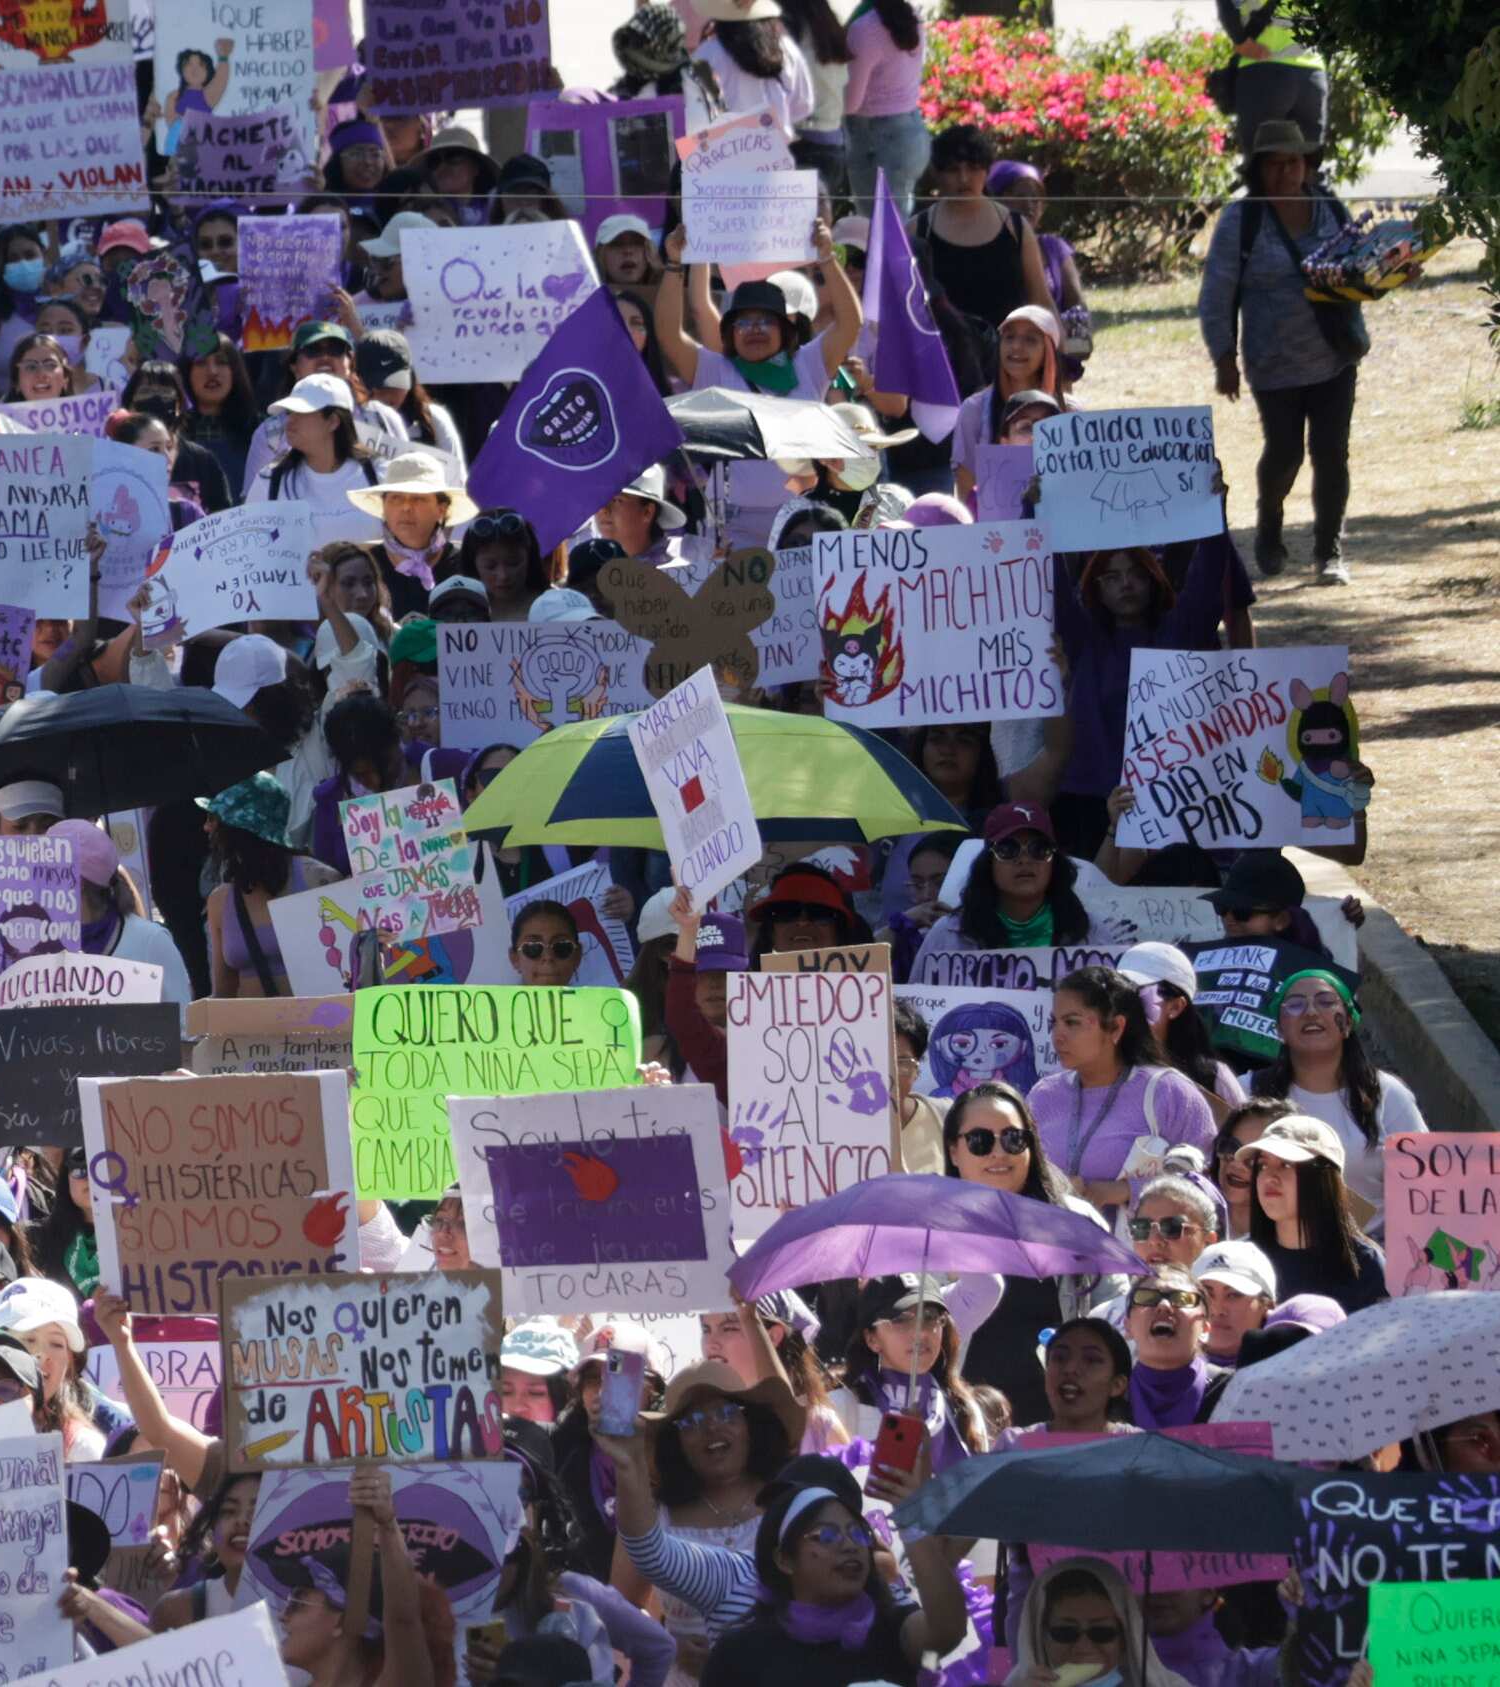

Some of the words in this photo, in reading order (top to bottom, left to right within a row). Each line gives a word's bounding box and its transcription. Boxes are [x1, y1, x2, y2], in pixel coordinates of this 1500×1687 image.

[246, 32, 309, 53] HABER
[234, 58, 304, 79] NACIDO
[26, 111, 55, 131] QUE
[64, 102, 136, 125] LUCHAN
[4, 143, 33, 162] POR
[40, 139, 79, 158] LAS
[86, 134, 124, 154] QUE
[223, 155, 252, 171] AL
[59, 162, 143, 190] VIOLAN
[440, 258, 502, 304] Que
[544, 395, 585, 436] GRITO
[1155, 417, 1181, 437] no
[724, 556, 767, 586] NO
[818, 530, 928, 575] MENOS
[898, 555, 1054, 633] MACHITOS
[446, 630, 478, 654] NO
[445, 663, 493, 687] VINE
[899, 668, 1057, 716] MICHITOS
[1129, 670, 1165, 713] POR
[1166, 651, 1207, 684] LAS
[1158, 656, 1258, 728] MUJERES
[443, 699, 497, 720] TENGO
[637, 681, 699, 746] MARCHO
[1123, 681, 1286, 787] ASESINADAS
[662, 739, 716, 788] VIVA
[1149, 764, 1209, 818] DÍA
[1213, 747, 1248, 784] EN
[346, 803, 380, 845] Soy
[1140, 818, 1169, 845] EL
[1177, 782, 1263, 846] PAÍS
[353, 846, 389, 873] De
[680, 820, 744, 890] CUANDO
[362, 881, 386, 898] QUE
[372, 990, 499, 1047] QUIERO
[511, 990, 583, 1048] QUE
[727, 972, 883, 1027] ¿MIEDO?
[97, 1026, 167, 1055] libres
[222, 1038, 240, 1060] A
[249, 1042, 270, 1058] mi
[763, 1026, 857, 1085] SOLO
[358, 1050, 452, 1089] TODA
[465, 1046, 540, 1090] NIÑA
[552, 1047, 626, 1089] SEPA
[105, 1096, 172, 1156] NO
[190, 1097, 304, 1154] SOMOS
[353, 1095, 420, 1132] QUE
[779, 1085, 834, 1146] AL
[143, 1152, 318, 1200] HISTÉRICAS
[736, 1145, 891, 1208] SILENCIO
[1396, 1137, 1473, 1180] SOY
[1409, 1188, 1446, 1215] DE
[1460, 1188, 1498, 1215] LA
[120, 1205, 281, 1252] SOMOS
[526, 1266, 688, 1304] TOCARAS
[266, 1302, 317, 1336] Nos
[247, 1389, 286, 1423] de
[304, 1384, 502, 1461] ARTISTAS
[1312, 1480, 1418, 1522] QUE
[1430, 1498, 1479, 1524] EL
[16, 1558, 50, 1594] de
[1319, 1544, 1387, 1592] NO
[1406, 1543, 1468, 1583] TE
